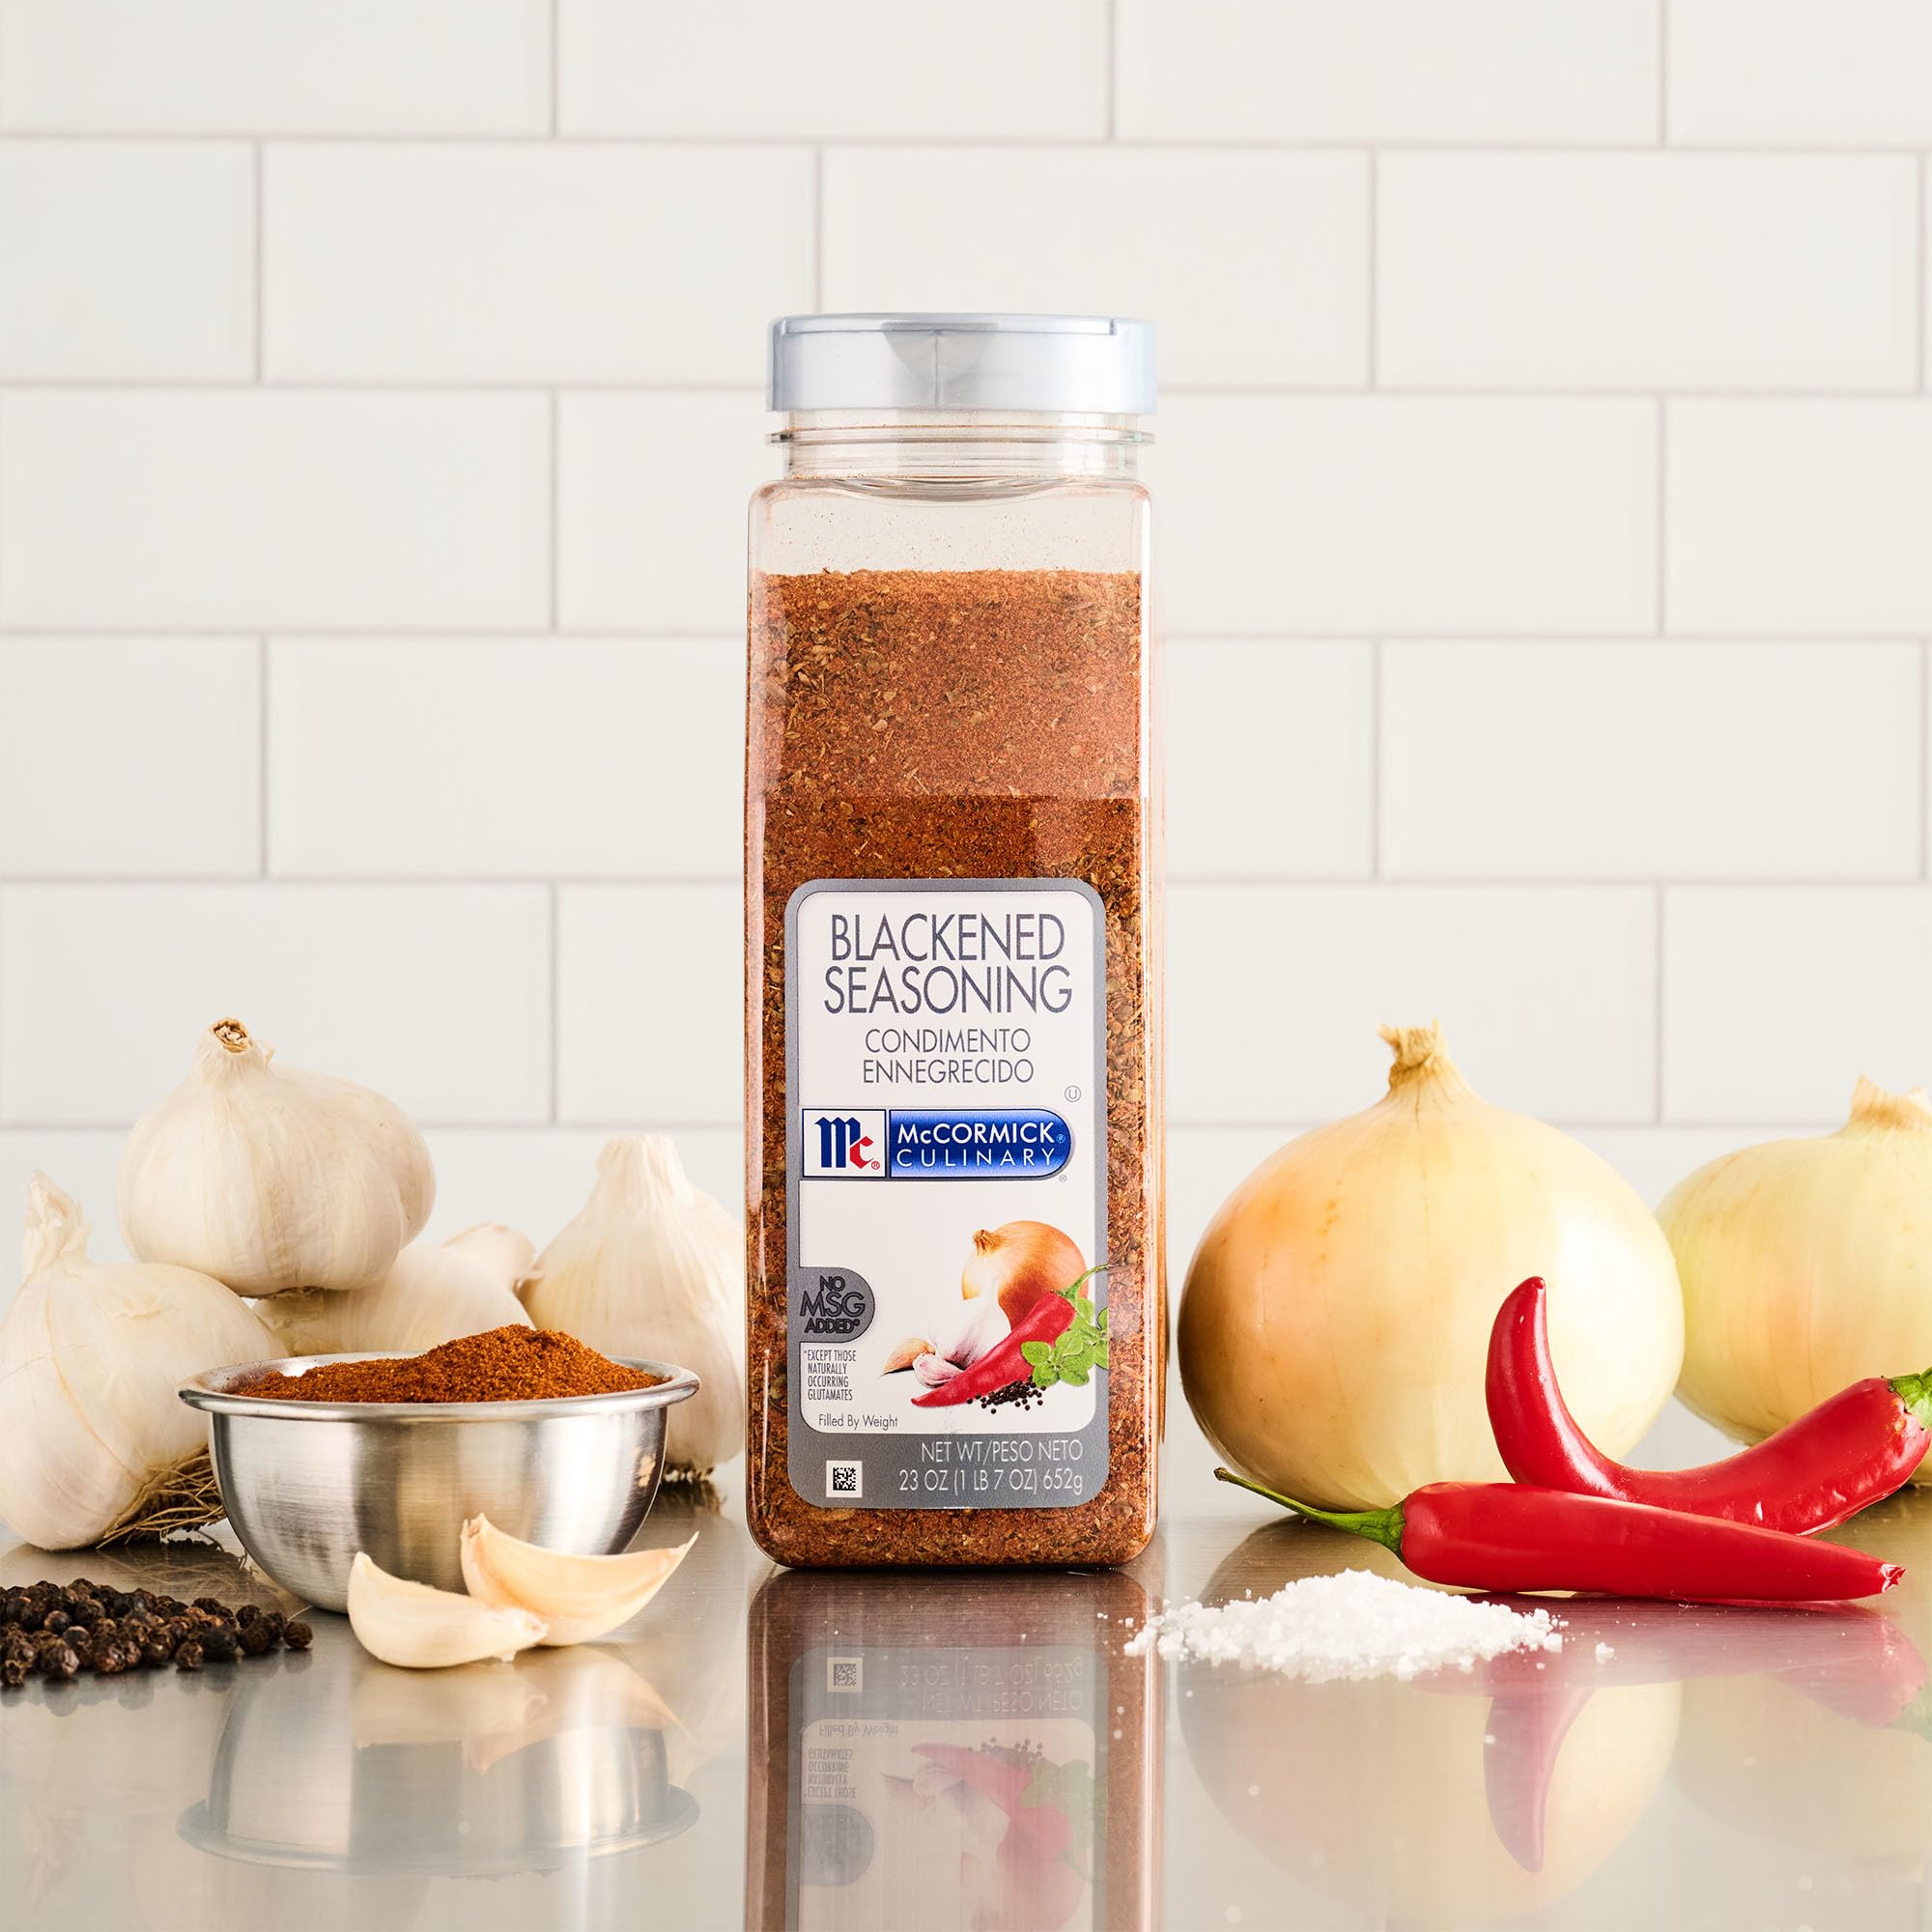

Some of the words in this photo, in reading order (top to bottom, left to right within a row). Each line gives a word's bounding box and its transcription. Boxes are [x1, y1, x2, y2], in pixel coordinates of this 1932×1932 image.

[831, 913, 1065, 961] BLACKENED
[823, 965, 1073, 1014] SEASONING
[865, 1028, 1031, 1053] CONDIMENTO
[863, 1058, 1034, 1084] ENNEGRECIDO
[896, 1148, 1055, 1167] CULINARY
[820, 1275, 845, 1292] NO
[800, 1291, 866, 1318] MSG
[834, 1350, 857, 1362] THOSE
[808, 1363, 847, 1375] NATURALLY
[808, 1376, 848, 1388] OCCURRING
[808, 1388, 853, 1401] GLUTAMATES
[818, 1413, 844, 1428] Filled
[847, 1413, 860, 1430] By
[863, 1414, 898, 1431] Weight
[922, 1440, 952, 1463] NET
[1038, 1439, 1083, 1462] NETO
[899, 1469, 918, 1491] 23
[924, 1469, 949, 1491] OZ
[953, 1468, 966, 1496] (1
[974, 1469, 989, 1491] LB
[994, 1469, 1004, 1491] 7
[1009, 1467, 1037, 1494] OZ)
[1042, 1467, 1083, 1495] 652g
